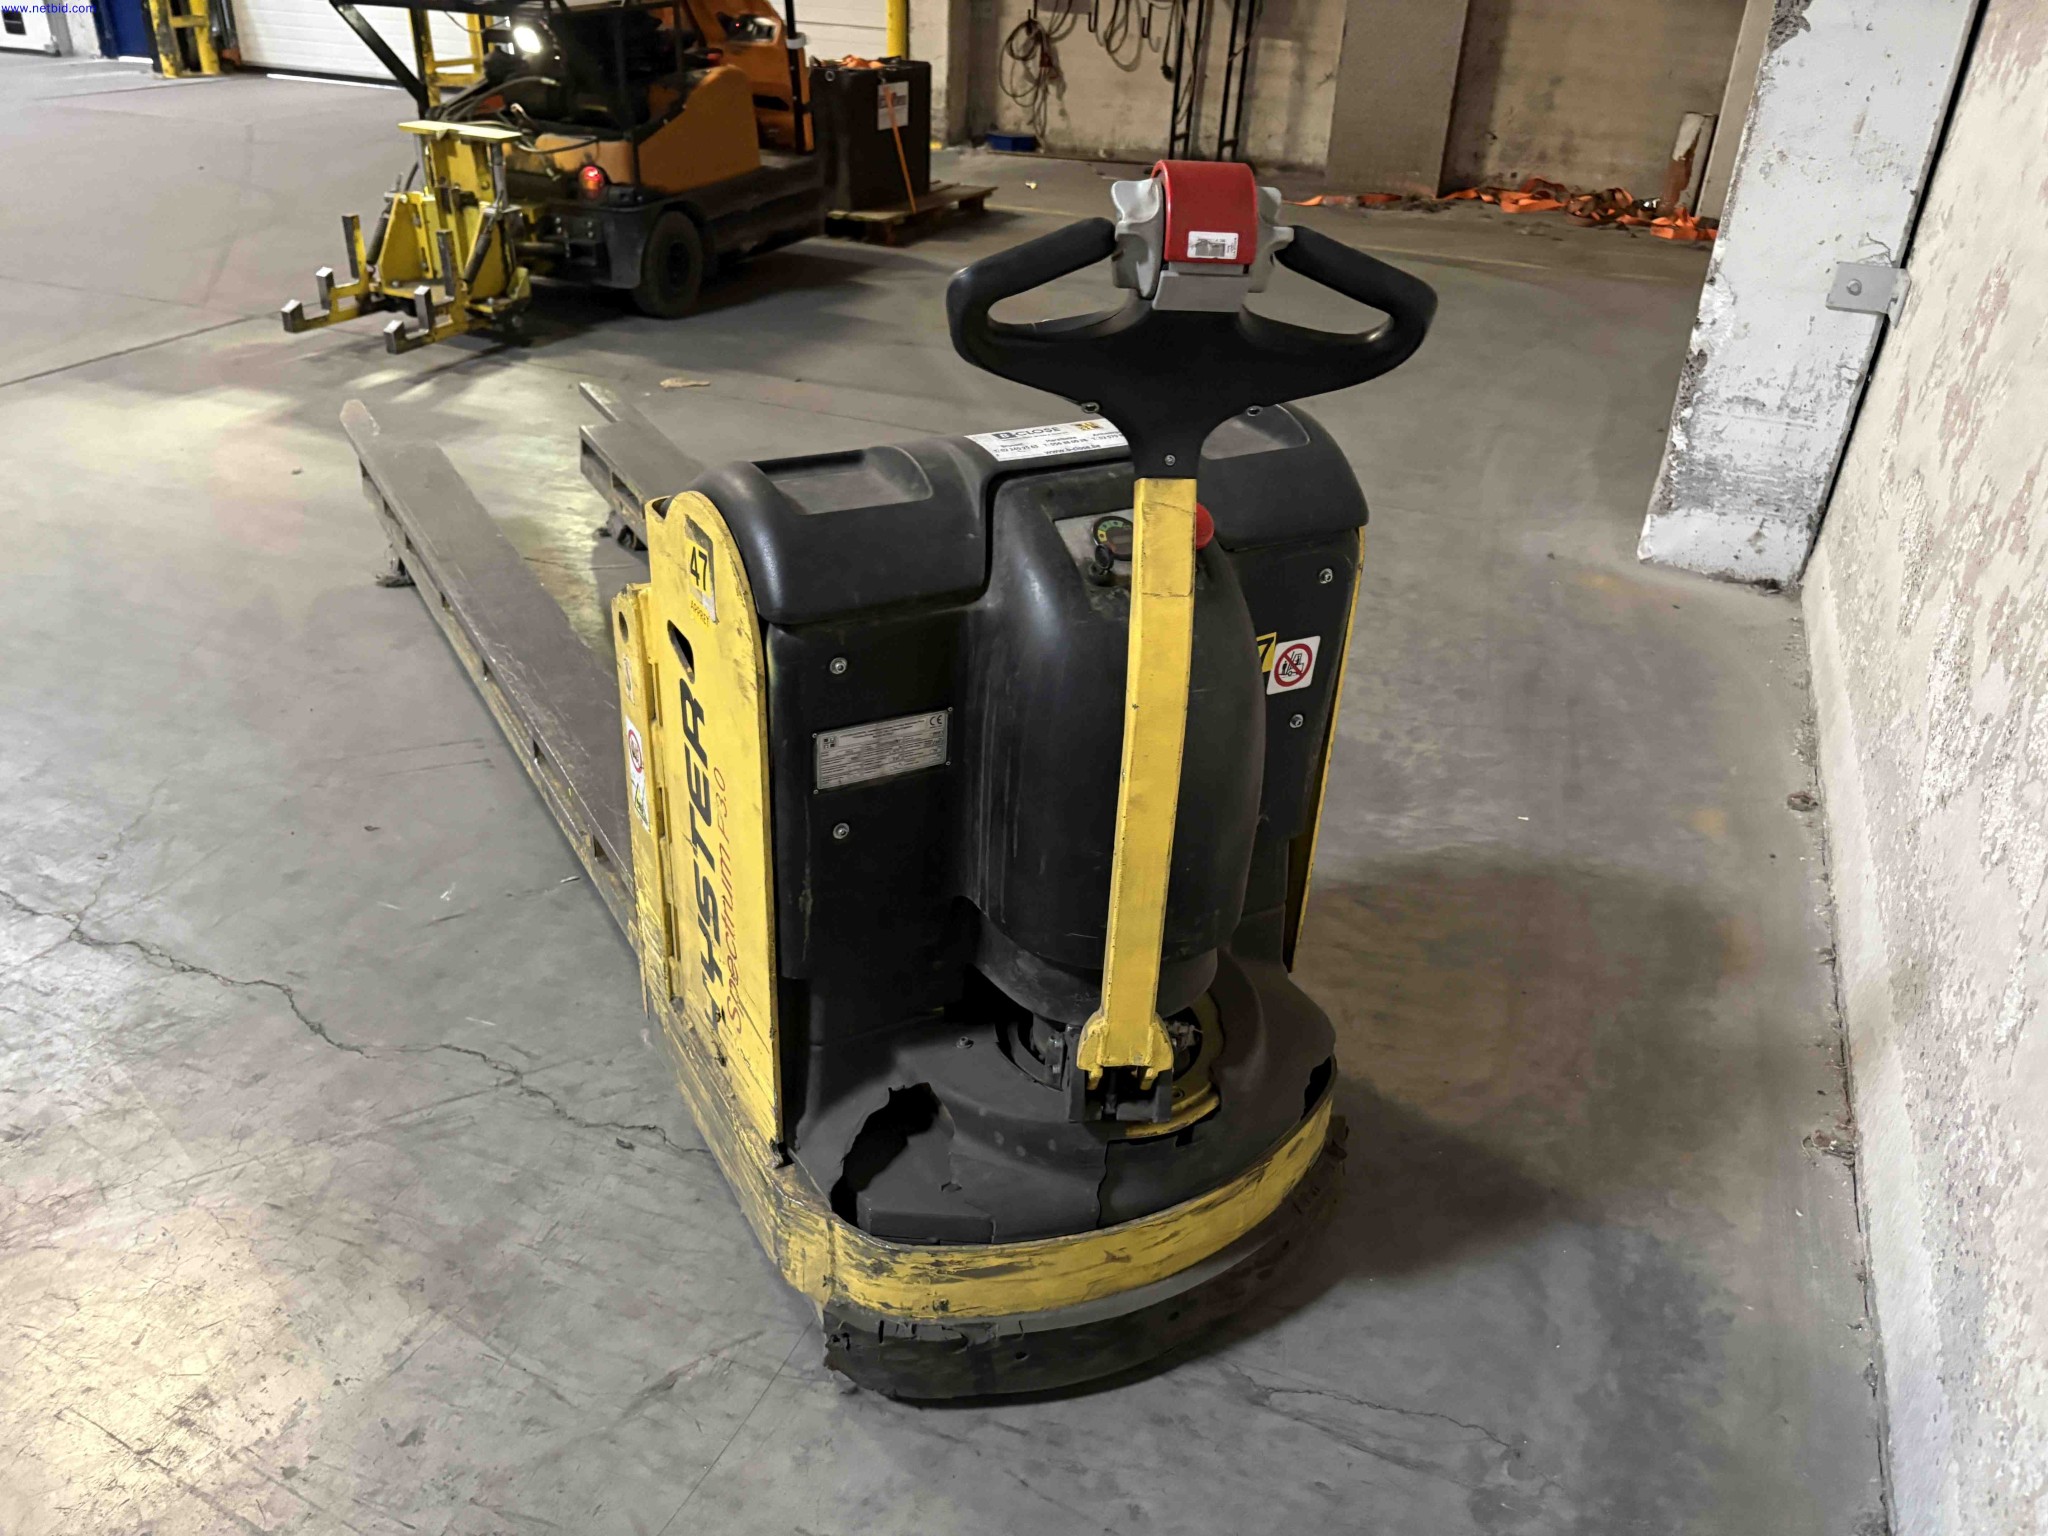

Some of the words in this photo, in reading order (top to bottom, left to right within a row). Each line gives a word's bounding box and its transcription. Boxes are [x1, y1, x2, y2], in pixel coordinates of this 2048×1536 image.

[1015, 426, 1061, 437] CLOSE
[690, 546, 708, 591] 47
[679, 678, 727, 1033] HYSTER
[715, 842, 744, 1035] Spectrum
